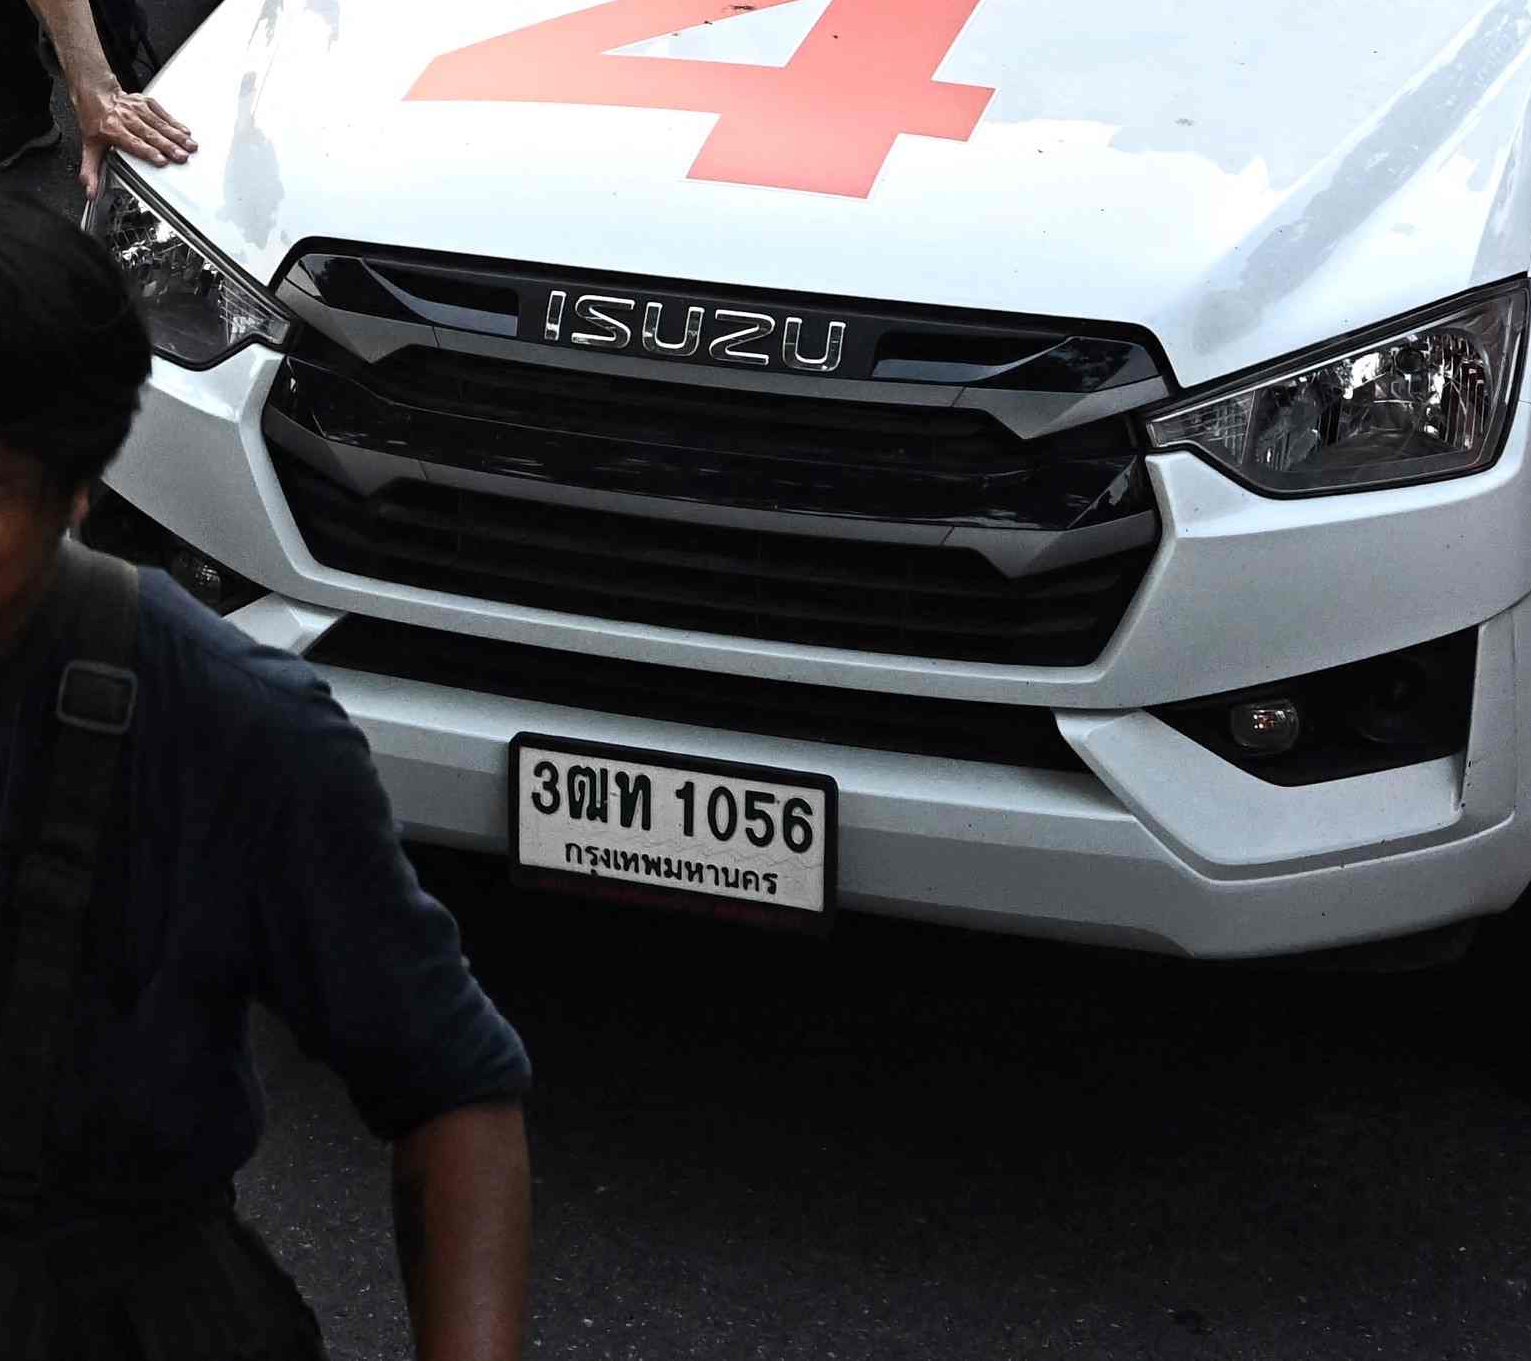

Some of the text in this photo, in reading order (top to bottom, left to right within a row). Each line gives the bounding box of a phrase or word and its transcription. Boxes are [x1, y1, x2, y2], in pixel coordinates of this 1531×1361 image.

[543, 289, 848, 373] ISUZU
[675, 781, 814, 854] 1056
[564, 842, 779, 896] กรุงเทพมหานคร
